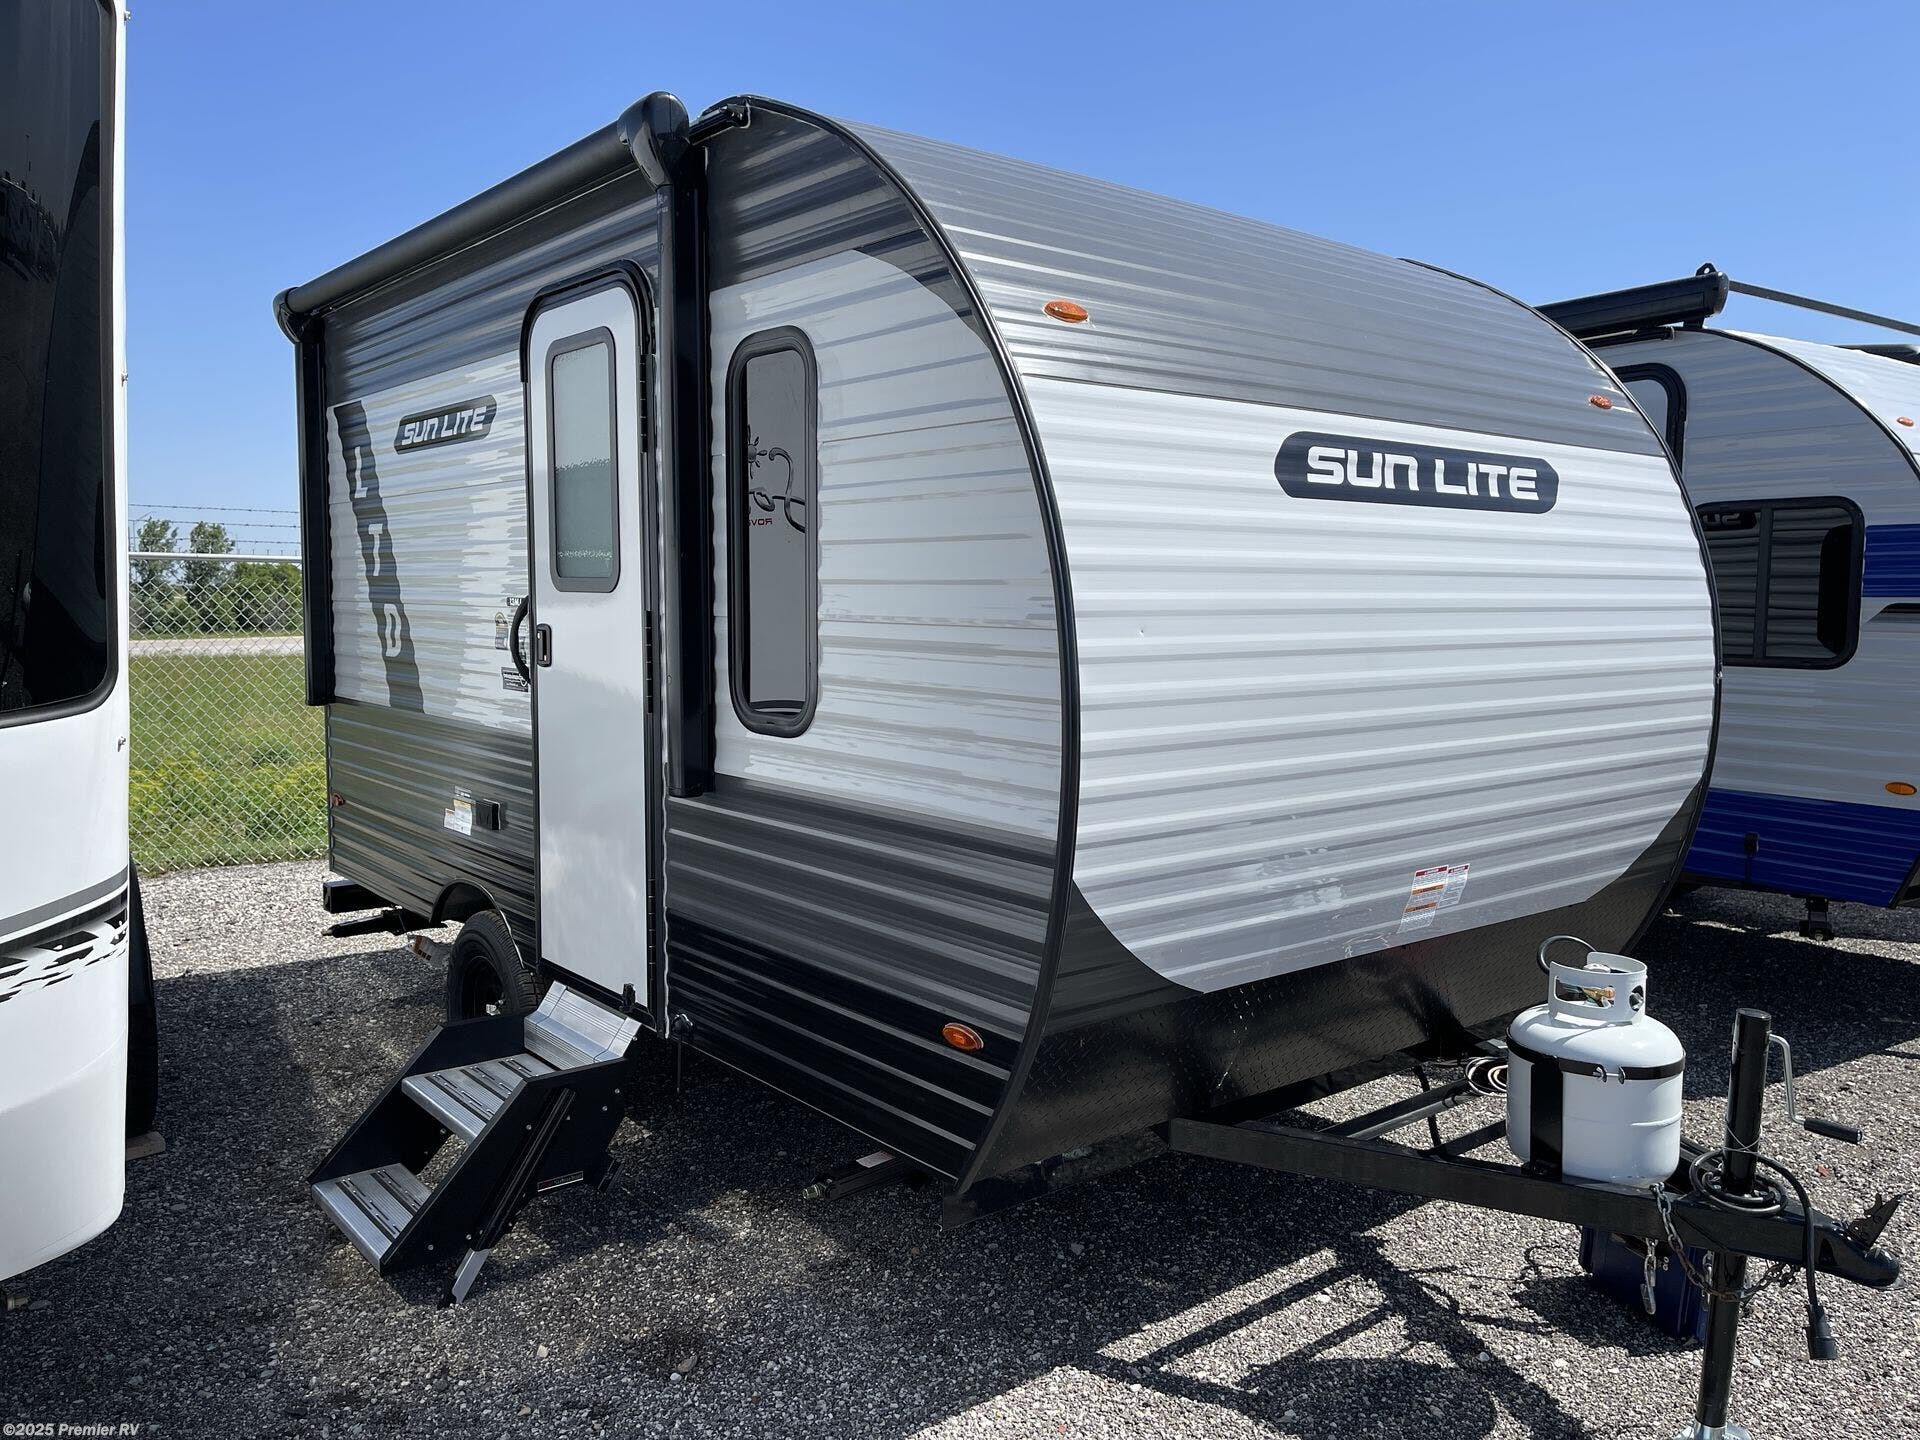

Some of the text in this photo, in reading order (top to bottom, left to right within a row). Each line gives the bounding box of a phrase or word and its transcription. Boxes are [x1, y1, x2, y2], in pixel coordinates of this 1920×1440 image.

[401, 406, 487, 446] SUN LITE
[1306, 445, 1540, 501] SUN LITE
